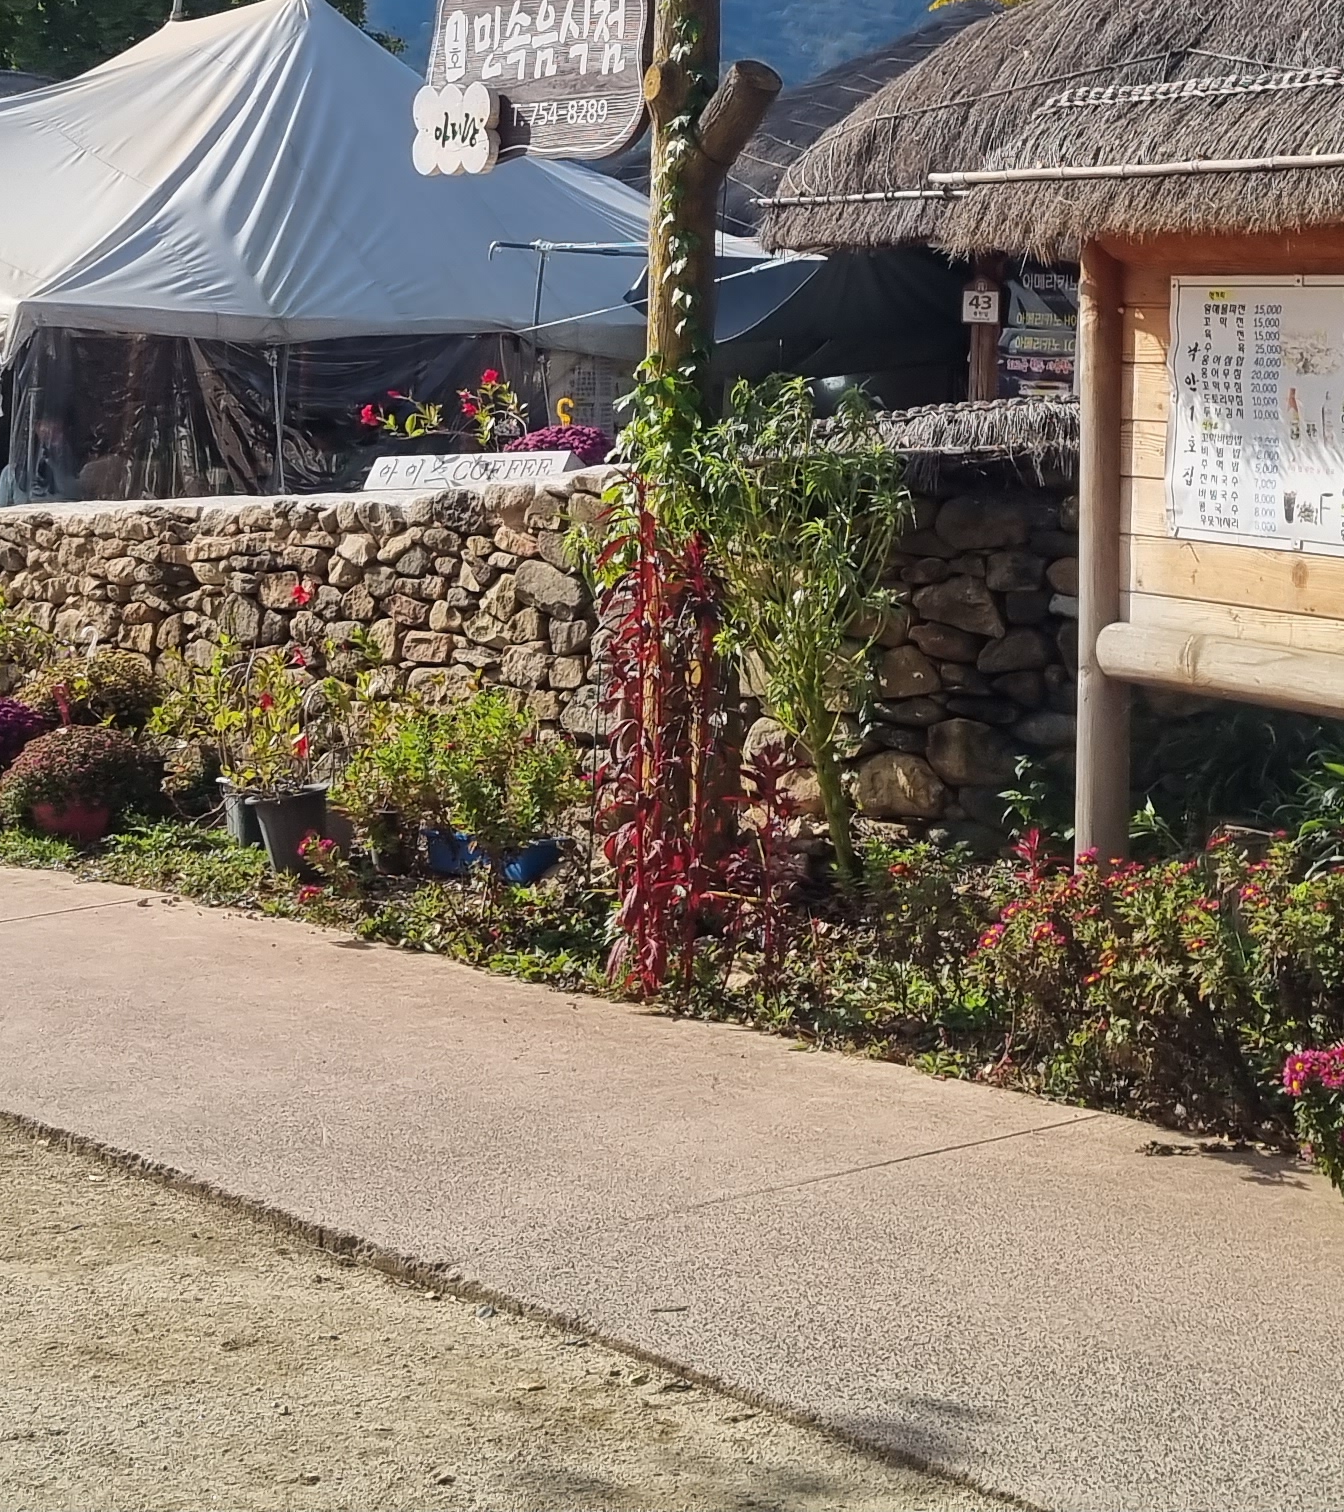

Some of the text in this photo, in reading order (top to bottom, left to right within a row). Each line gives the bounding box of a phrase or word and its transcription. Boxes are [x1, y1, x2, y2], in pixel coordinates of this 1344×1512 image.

[1022, 273, 1078, 290] 아메리카노
[969, 295, 992, 310] 43
[1254, 305, 1282, 316] 15,000
[1016, 312, 1062, 326] 아메리카노
[1253, 318, 1280, 329] 15,000
[1254, 330, 1280, 341] 15,000
[1015, 336, 1060, 350] 아메리카노
[1255, 344, 1282, 355] 25,000
[1254, 357, 1281, 368] 40,000
[1251, 370, 1279, 381] 20,000
[1251, 382, 1277, 393] 20,000
[1252, 397, 1278, 407] 10,000
[1253, 410, 1279, 420] 10,000
[452, 458, 554, 482] COFFEE
